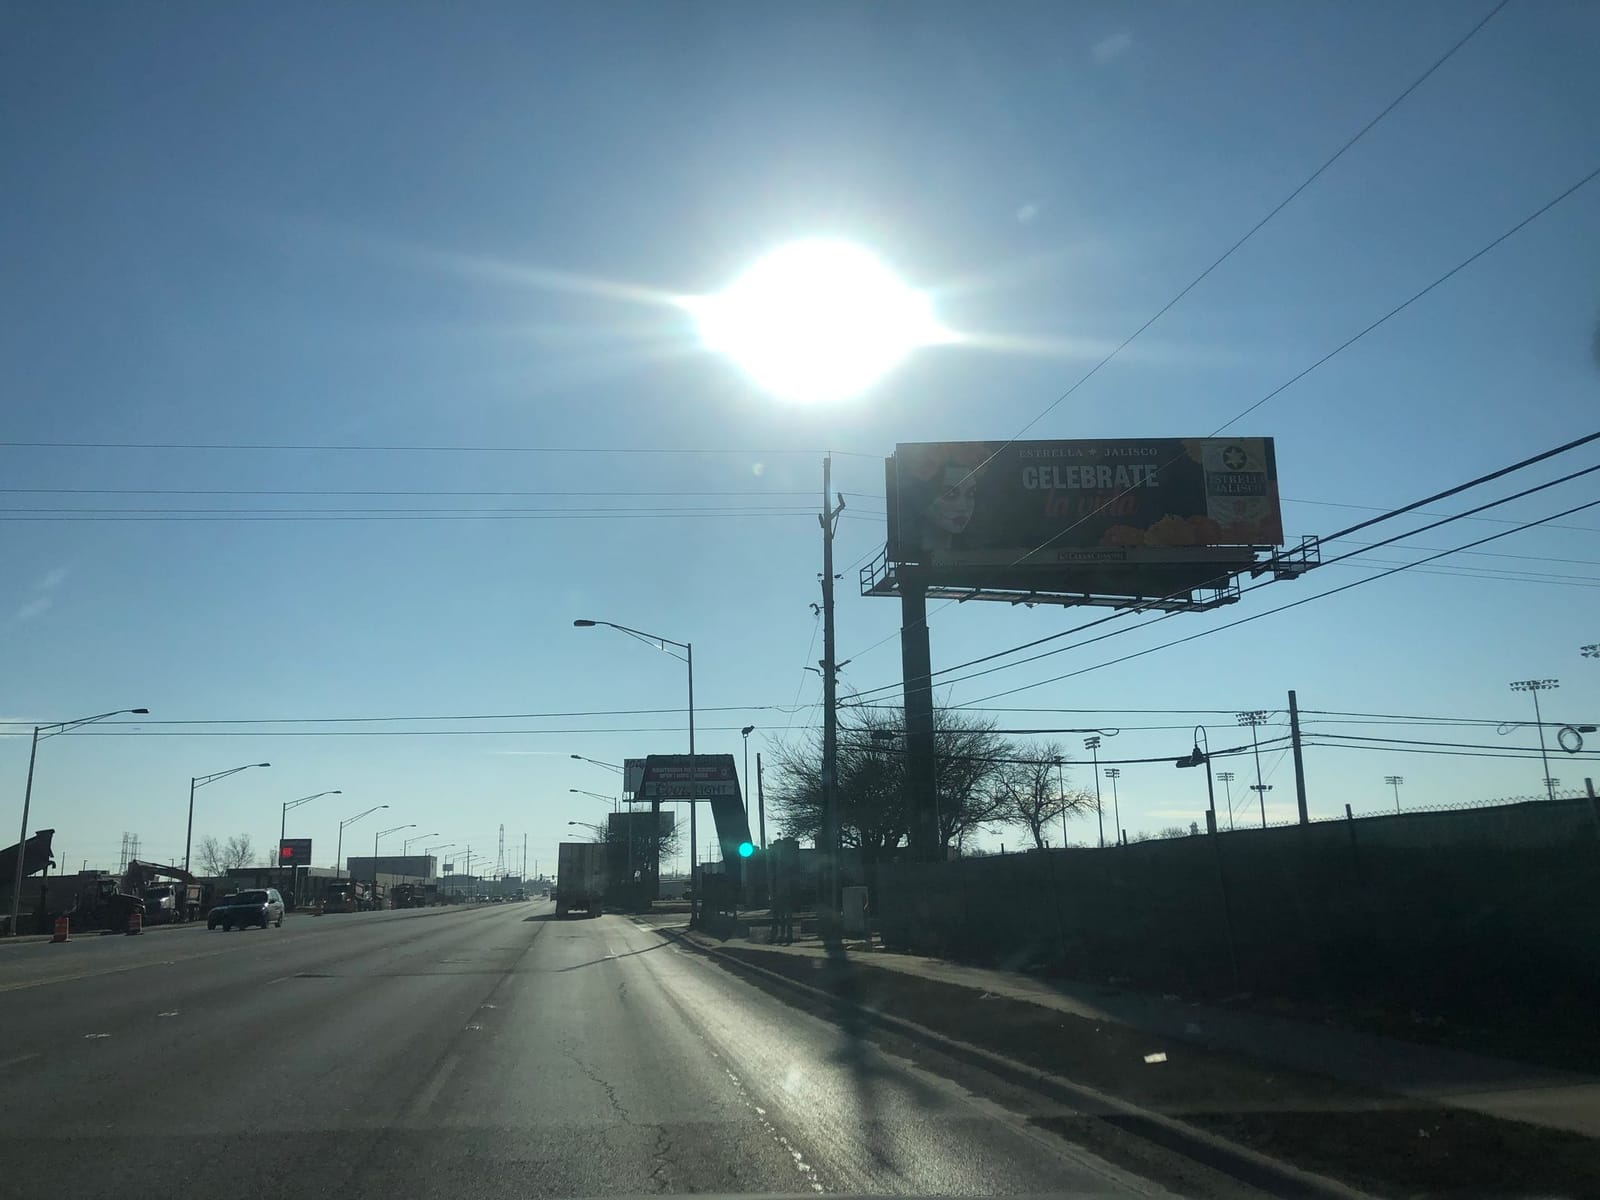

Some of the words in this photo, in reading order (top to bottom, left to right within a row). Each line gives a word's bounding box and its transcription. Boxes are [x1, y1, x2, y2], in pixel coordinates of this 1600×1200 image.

[1018, 447, 1083, 458] ESTRELLA
[1104, 446, 1159, 457] JALISCO
[1022, 464, 1160, 489] CELEBRATE
